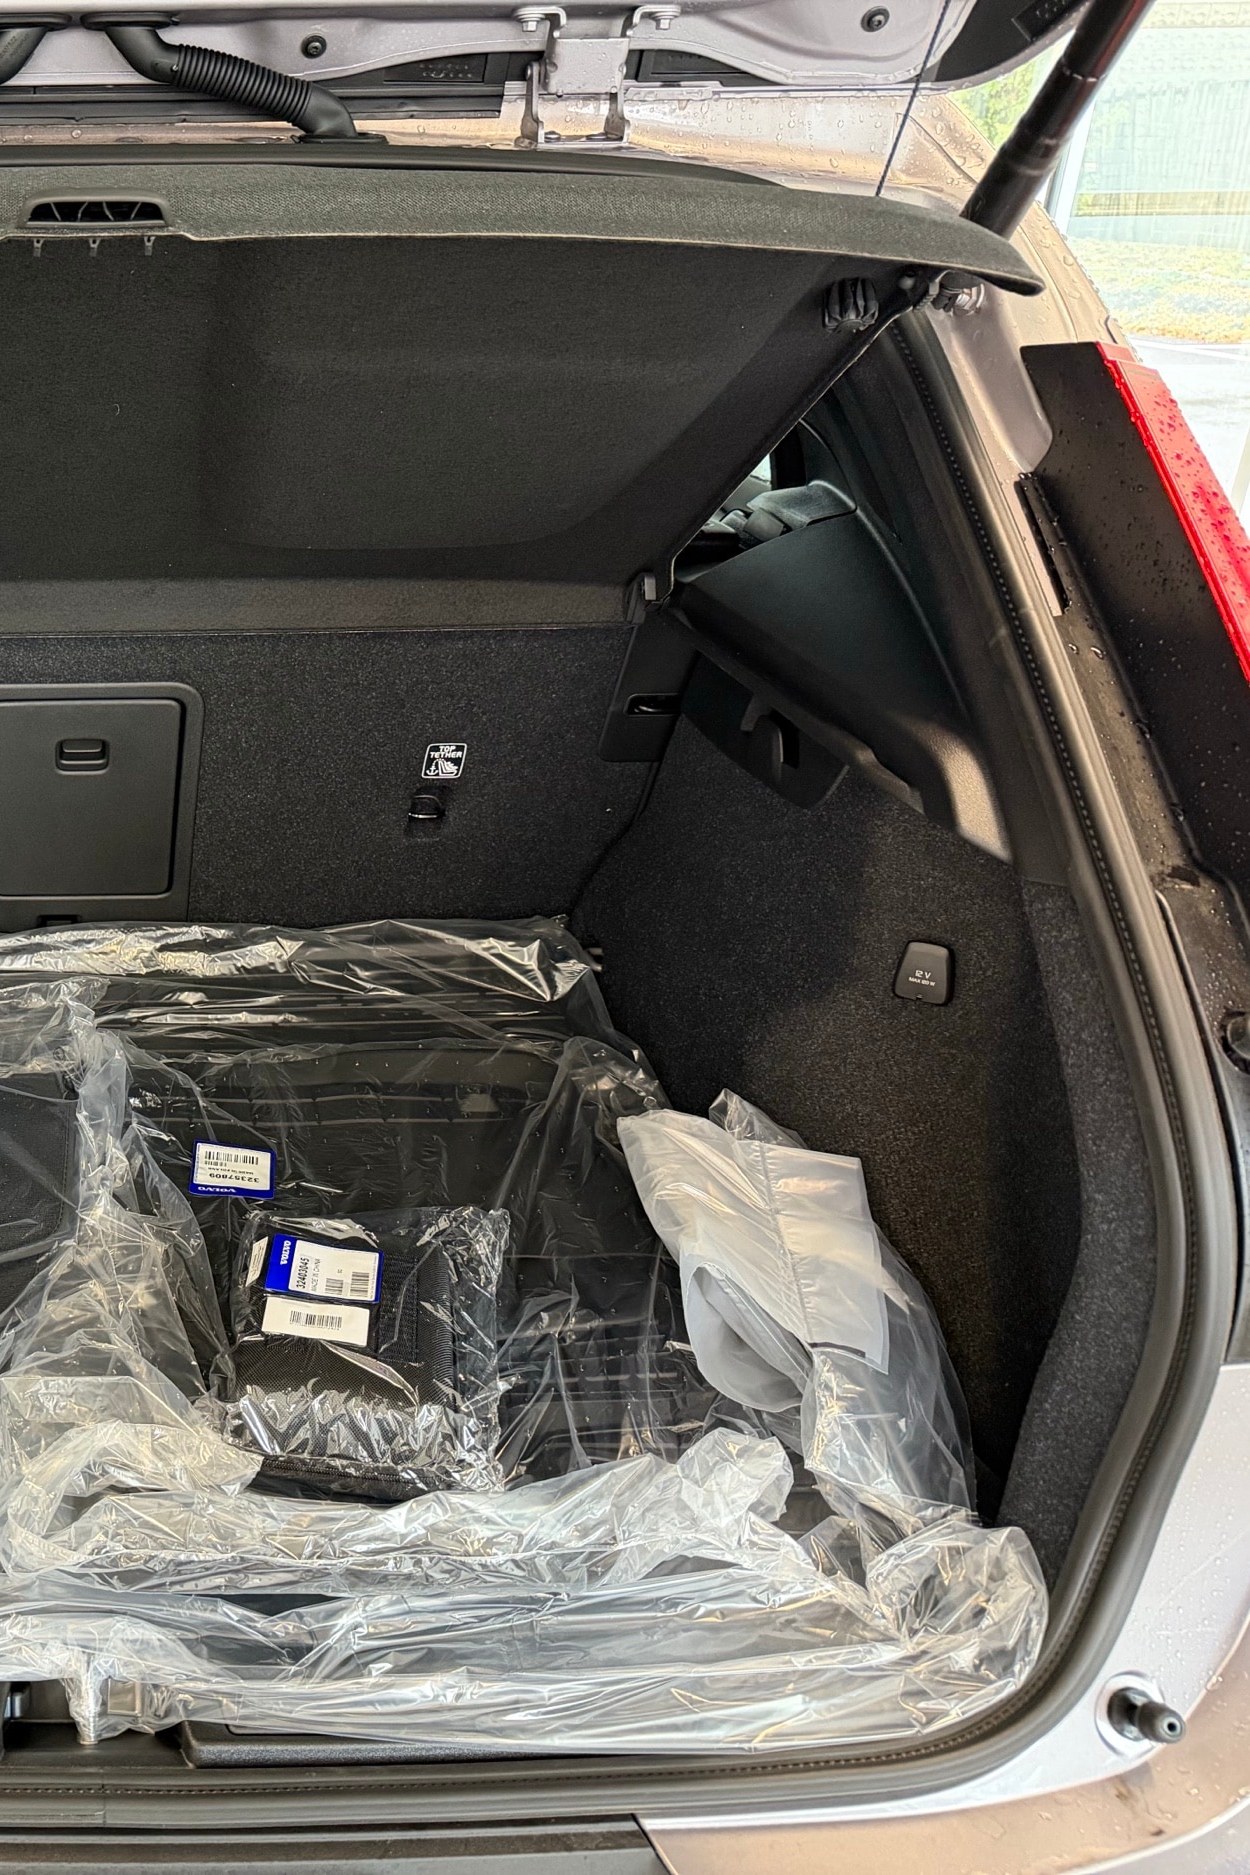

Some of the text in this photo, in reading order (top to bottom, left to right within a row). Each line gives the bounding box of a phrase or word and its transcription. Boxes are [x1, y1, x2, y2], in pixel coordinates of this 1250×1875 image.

[915, 970, 924, 978] 12
[279, 1240, 291, 1265] VOLVO
[296, 1257, 309, 1289] 32403045
[313, 1258, 321, 1273] CHINA
[310, 1278, 318, 1292] MADE
